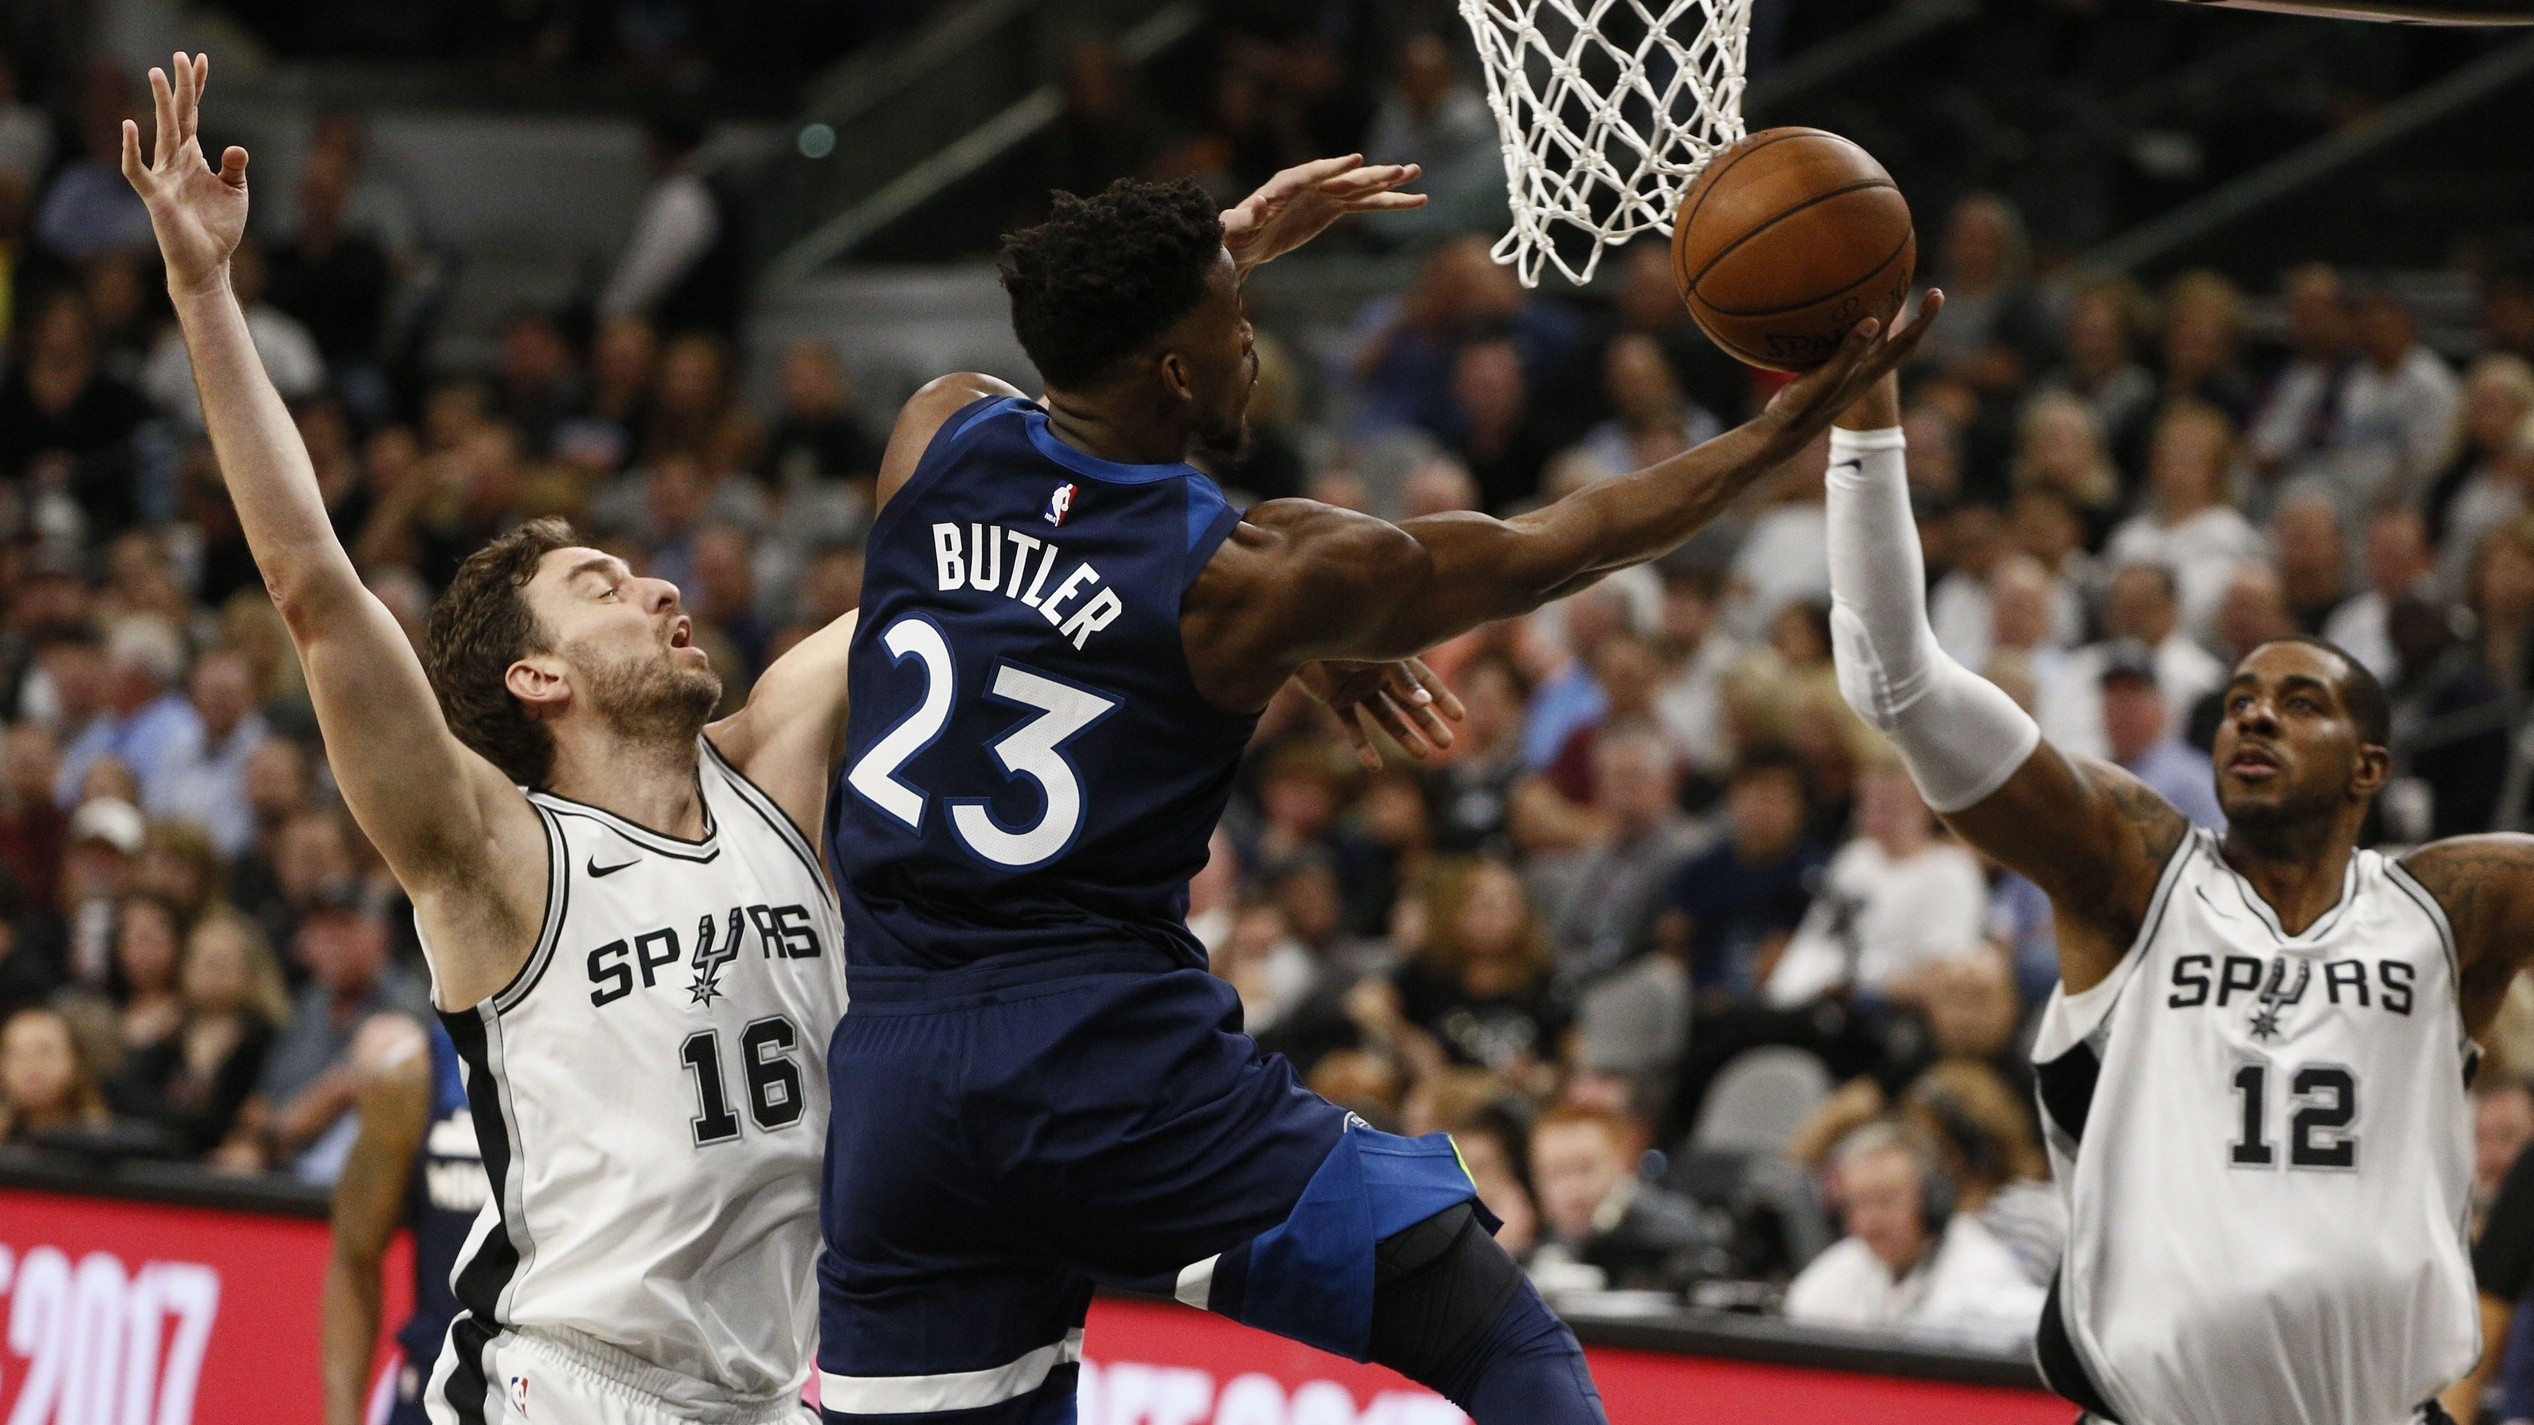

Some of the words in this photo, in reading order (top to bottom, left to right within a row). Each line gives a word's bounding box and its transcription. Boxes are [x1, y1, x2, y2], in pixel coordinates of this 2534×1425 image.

[932, 522, 1122, 651] BUTLER
[847, 614, 1120, 870] 23
[587, 904, 821, 1008] SPURS
[2168, 955, 2415, 1040] SPURS
[679, 1014, 806, 1148] 16
[2227, 1061, 2358, 1171] 12
